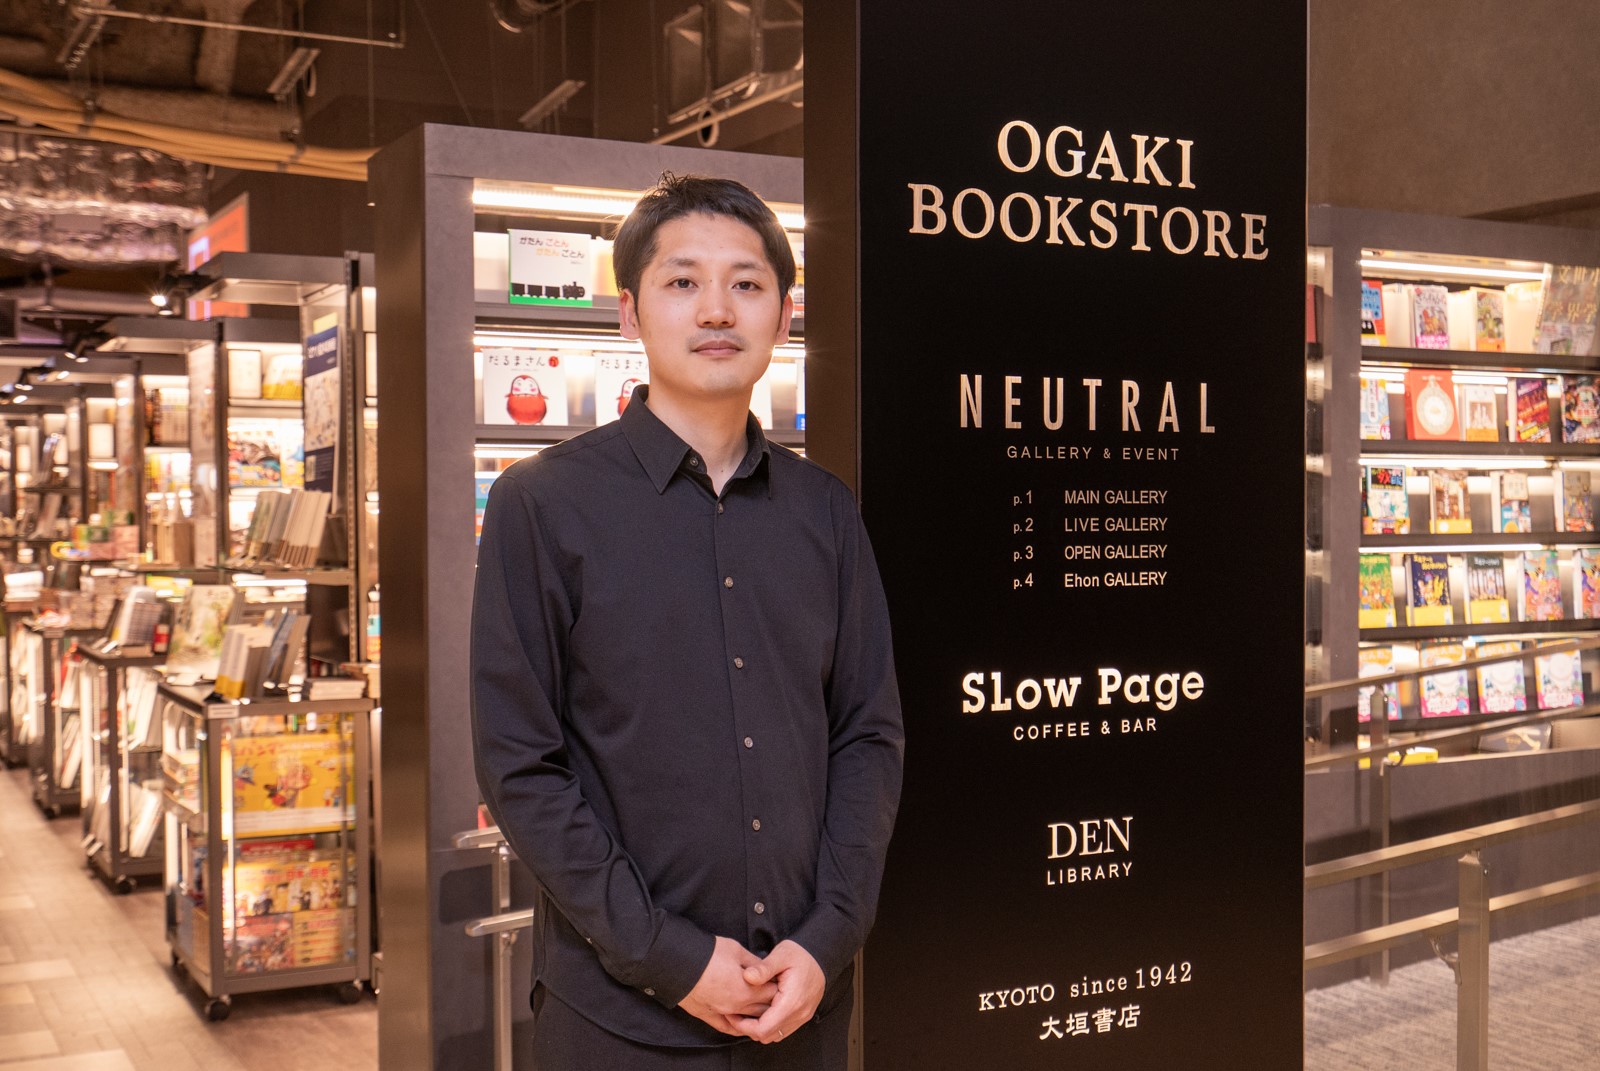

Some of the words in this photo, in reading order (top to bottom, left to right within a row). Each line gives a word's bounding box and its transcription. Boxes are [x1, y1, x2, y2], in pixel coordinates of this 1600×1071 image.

[997, 119, 1197, 190] OGAKI
[907, 182, 1269, 261] BOOKSTORE
[600, 359, 648, 370] だるまさ
[960, 373, 1216, 434] NEUTRAL
[1006, 445, 1092, 460] GALLERY
[1103, 447, 1111, 459] &
[1122, 447, 1180, 461] EVENT
[1064, 490, 1100, 504] MAIN
[1104, 490, 1168, 504] GALLERY
[1064, 518, 1100, 532] LIVE
[1104, 517, 1168, 532] GALLERY
[1064, 546, 1100, 560] OPEN
[1104, 544, 1168, 560] GALLERY
[1064, 573, 1100, 588] Ehon
[1104, 571, 1168, 587] GALLERY
[1097, 667, 1205, 712] Page
[1013, 721, 1090, 741] COFFEE
[1100, 720, 1111, 735] &
[1121, 717, 1157, 734] BAR
[1047, 815, 1134, 860] DEN
[1046, 861, 1133, 886] LIBRARY
[978, 982, 1056, 1012] KYOTO
[1069, 975, 1128, 998] since
[1135, 960, 1192, 990] 1942
[1038, 1002, 1141, 1041] 大垣書店
